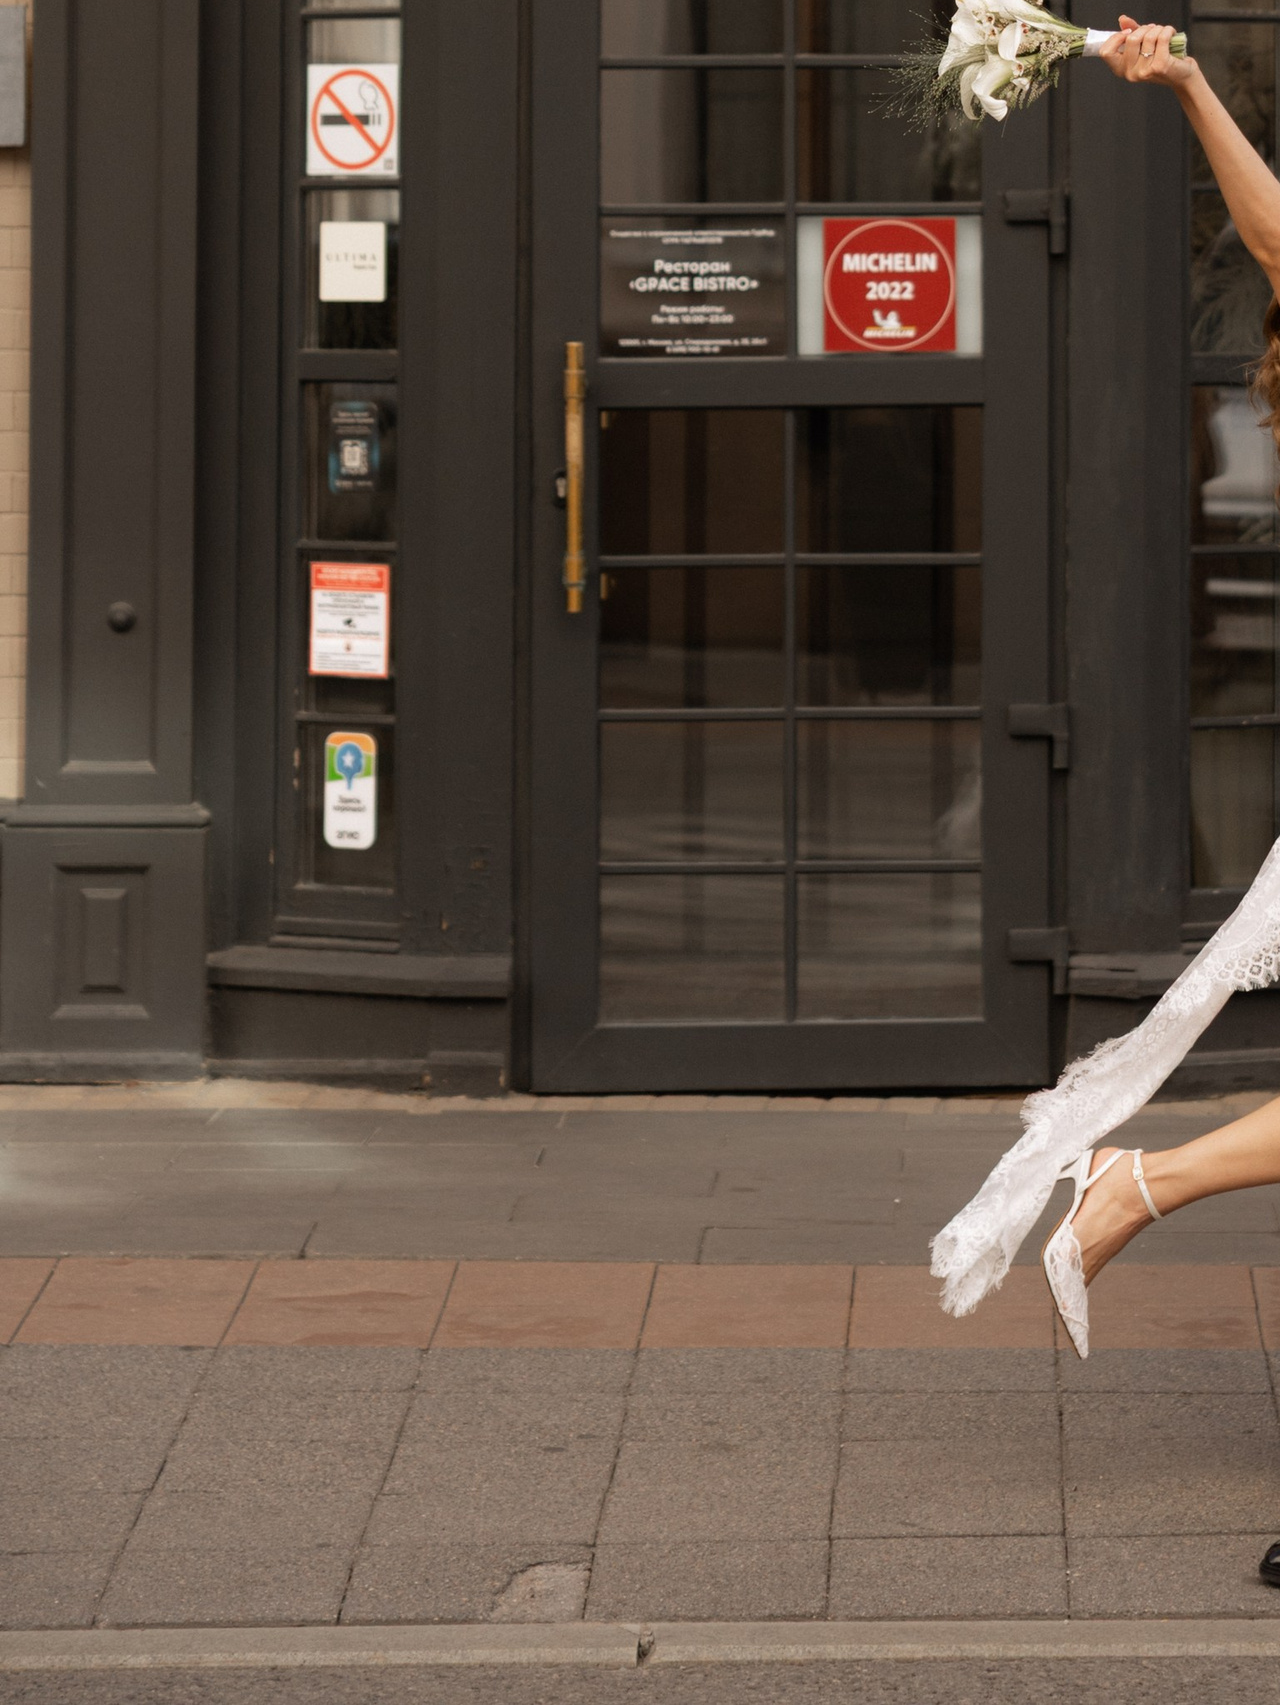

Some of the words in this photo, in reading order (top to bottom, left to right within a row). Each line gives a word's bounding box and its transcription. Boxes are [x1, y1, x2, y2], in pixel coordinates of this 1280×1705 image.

[653, 259, 732, 275] Ресторан
[842, 252, 938, 273] MICHELIN
[865, 280, 916, 301] 2022
